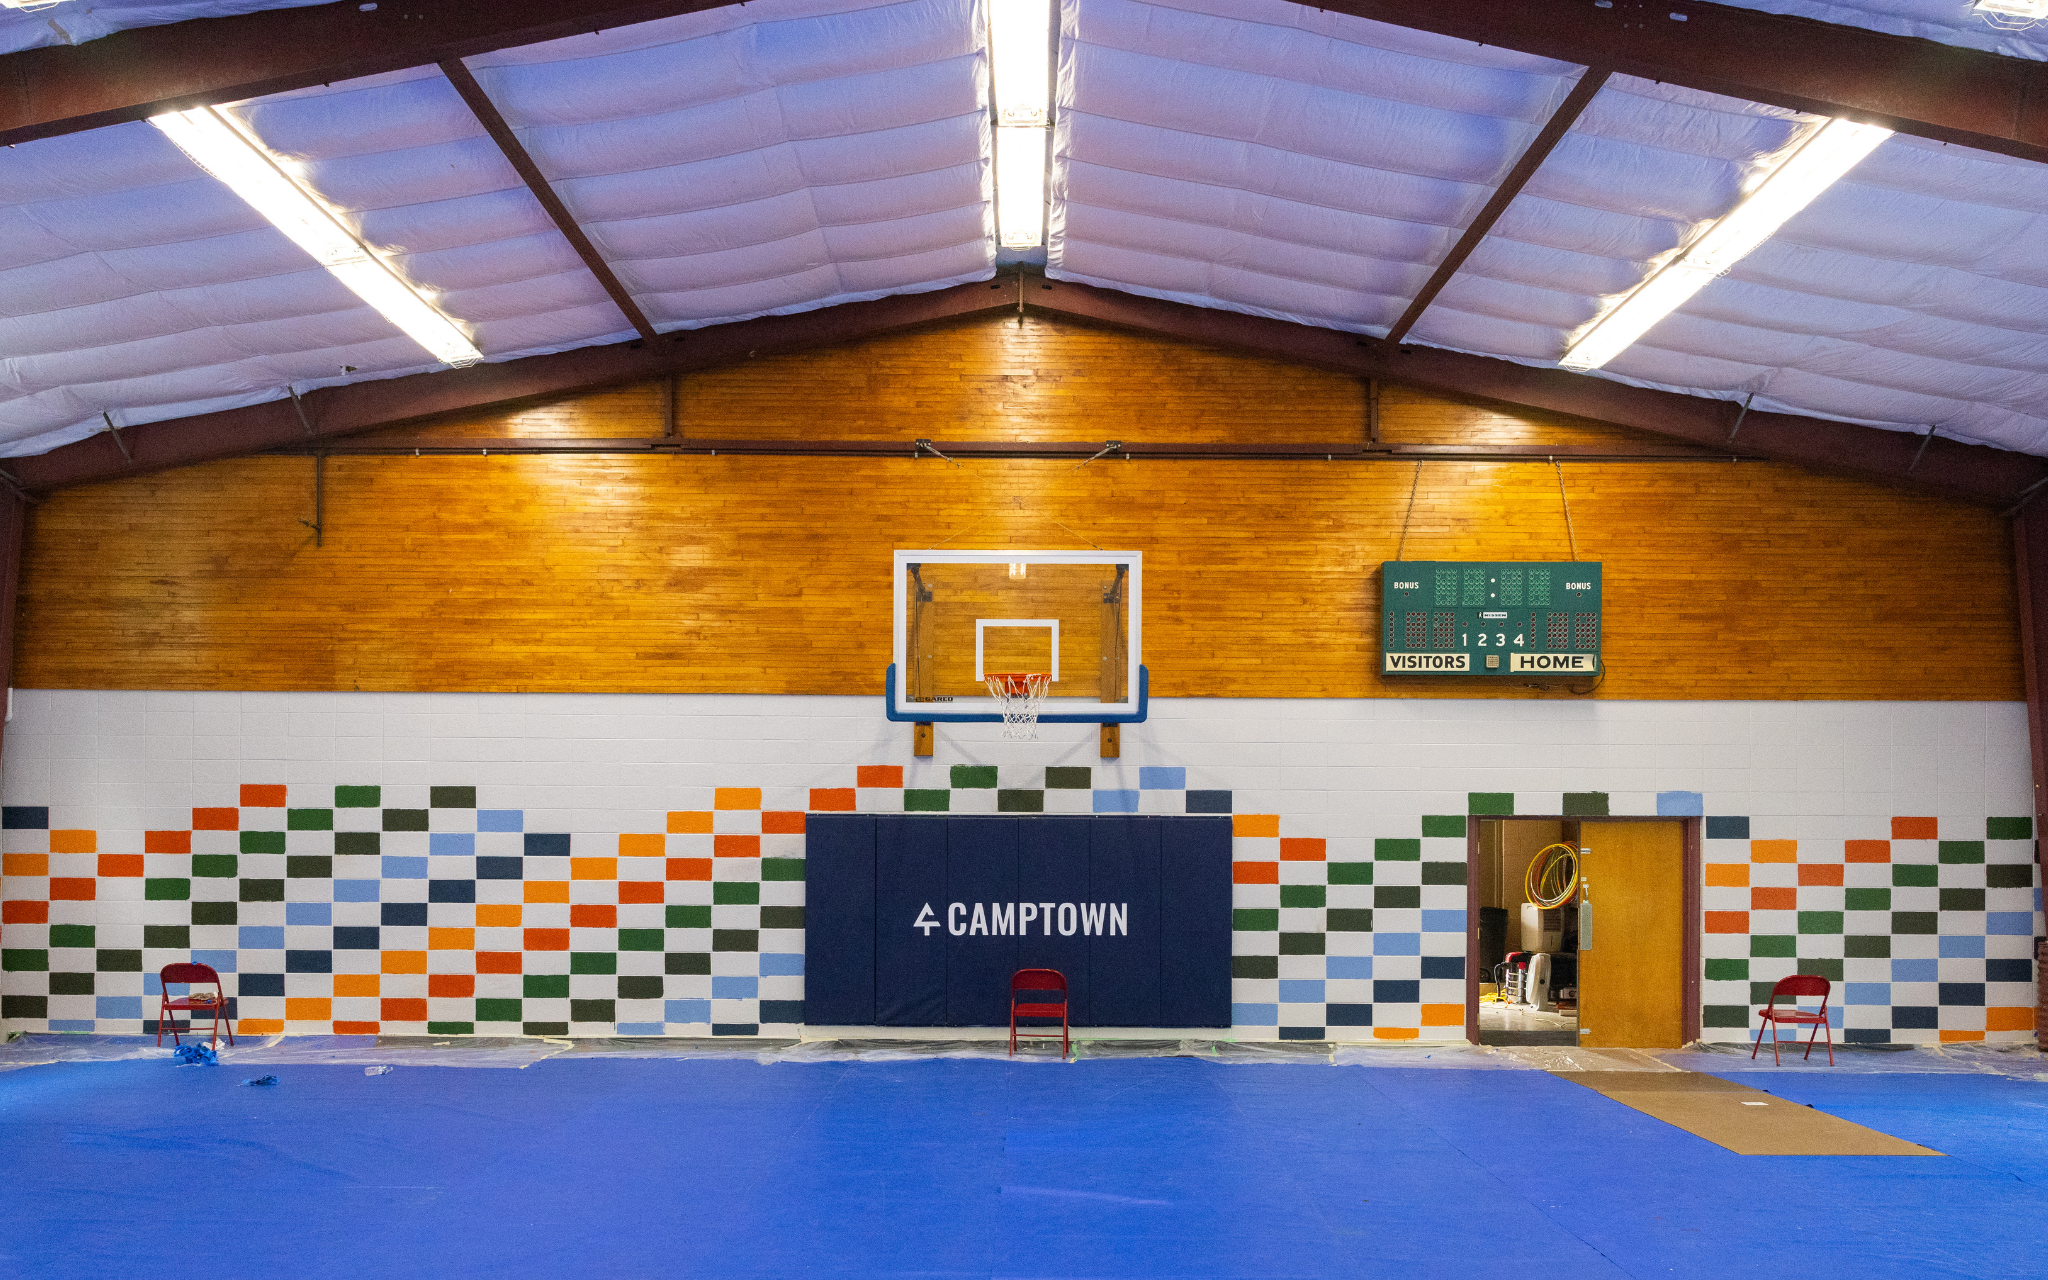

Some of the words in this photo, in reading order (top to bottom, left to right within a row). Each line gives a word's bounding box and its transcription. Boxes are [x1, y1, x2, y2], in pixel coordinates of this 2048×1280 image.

[1393, 581, 1419, 589] BONUS
[1565, 582, 1591, 590] BONUS
[1462, 633, 1467, 646] 1
[1478, 633, 1487, 646] 2
[1496, 633, 1505, 646] 3
[1513, 633, 1524, 646] 4
[1390, 655, 1466, 669] VISITORS
[1520, 656, 1584, 669] HOME
[948, 902, 1128, 936] CAMPTOWN
